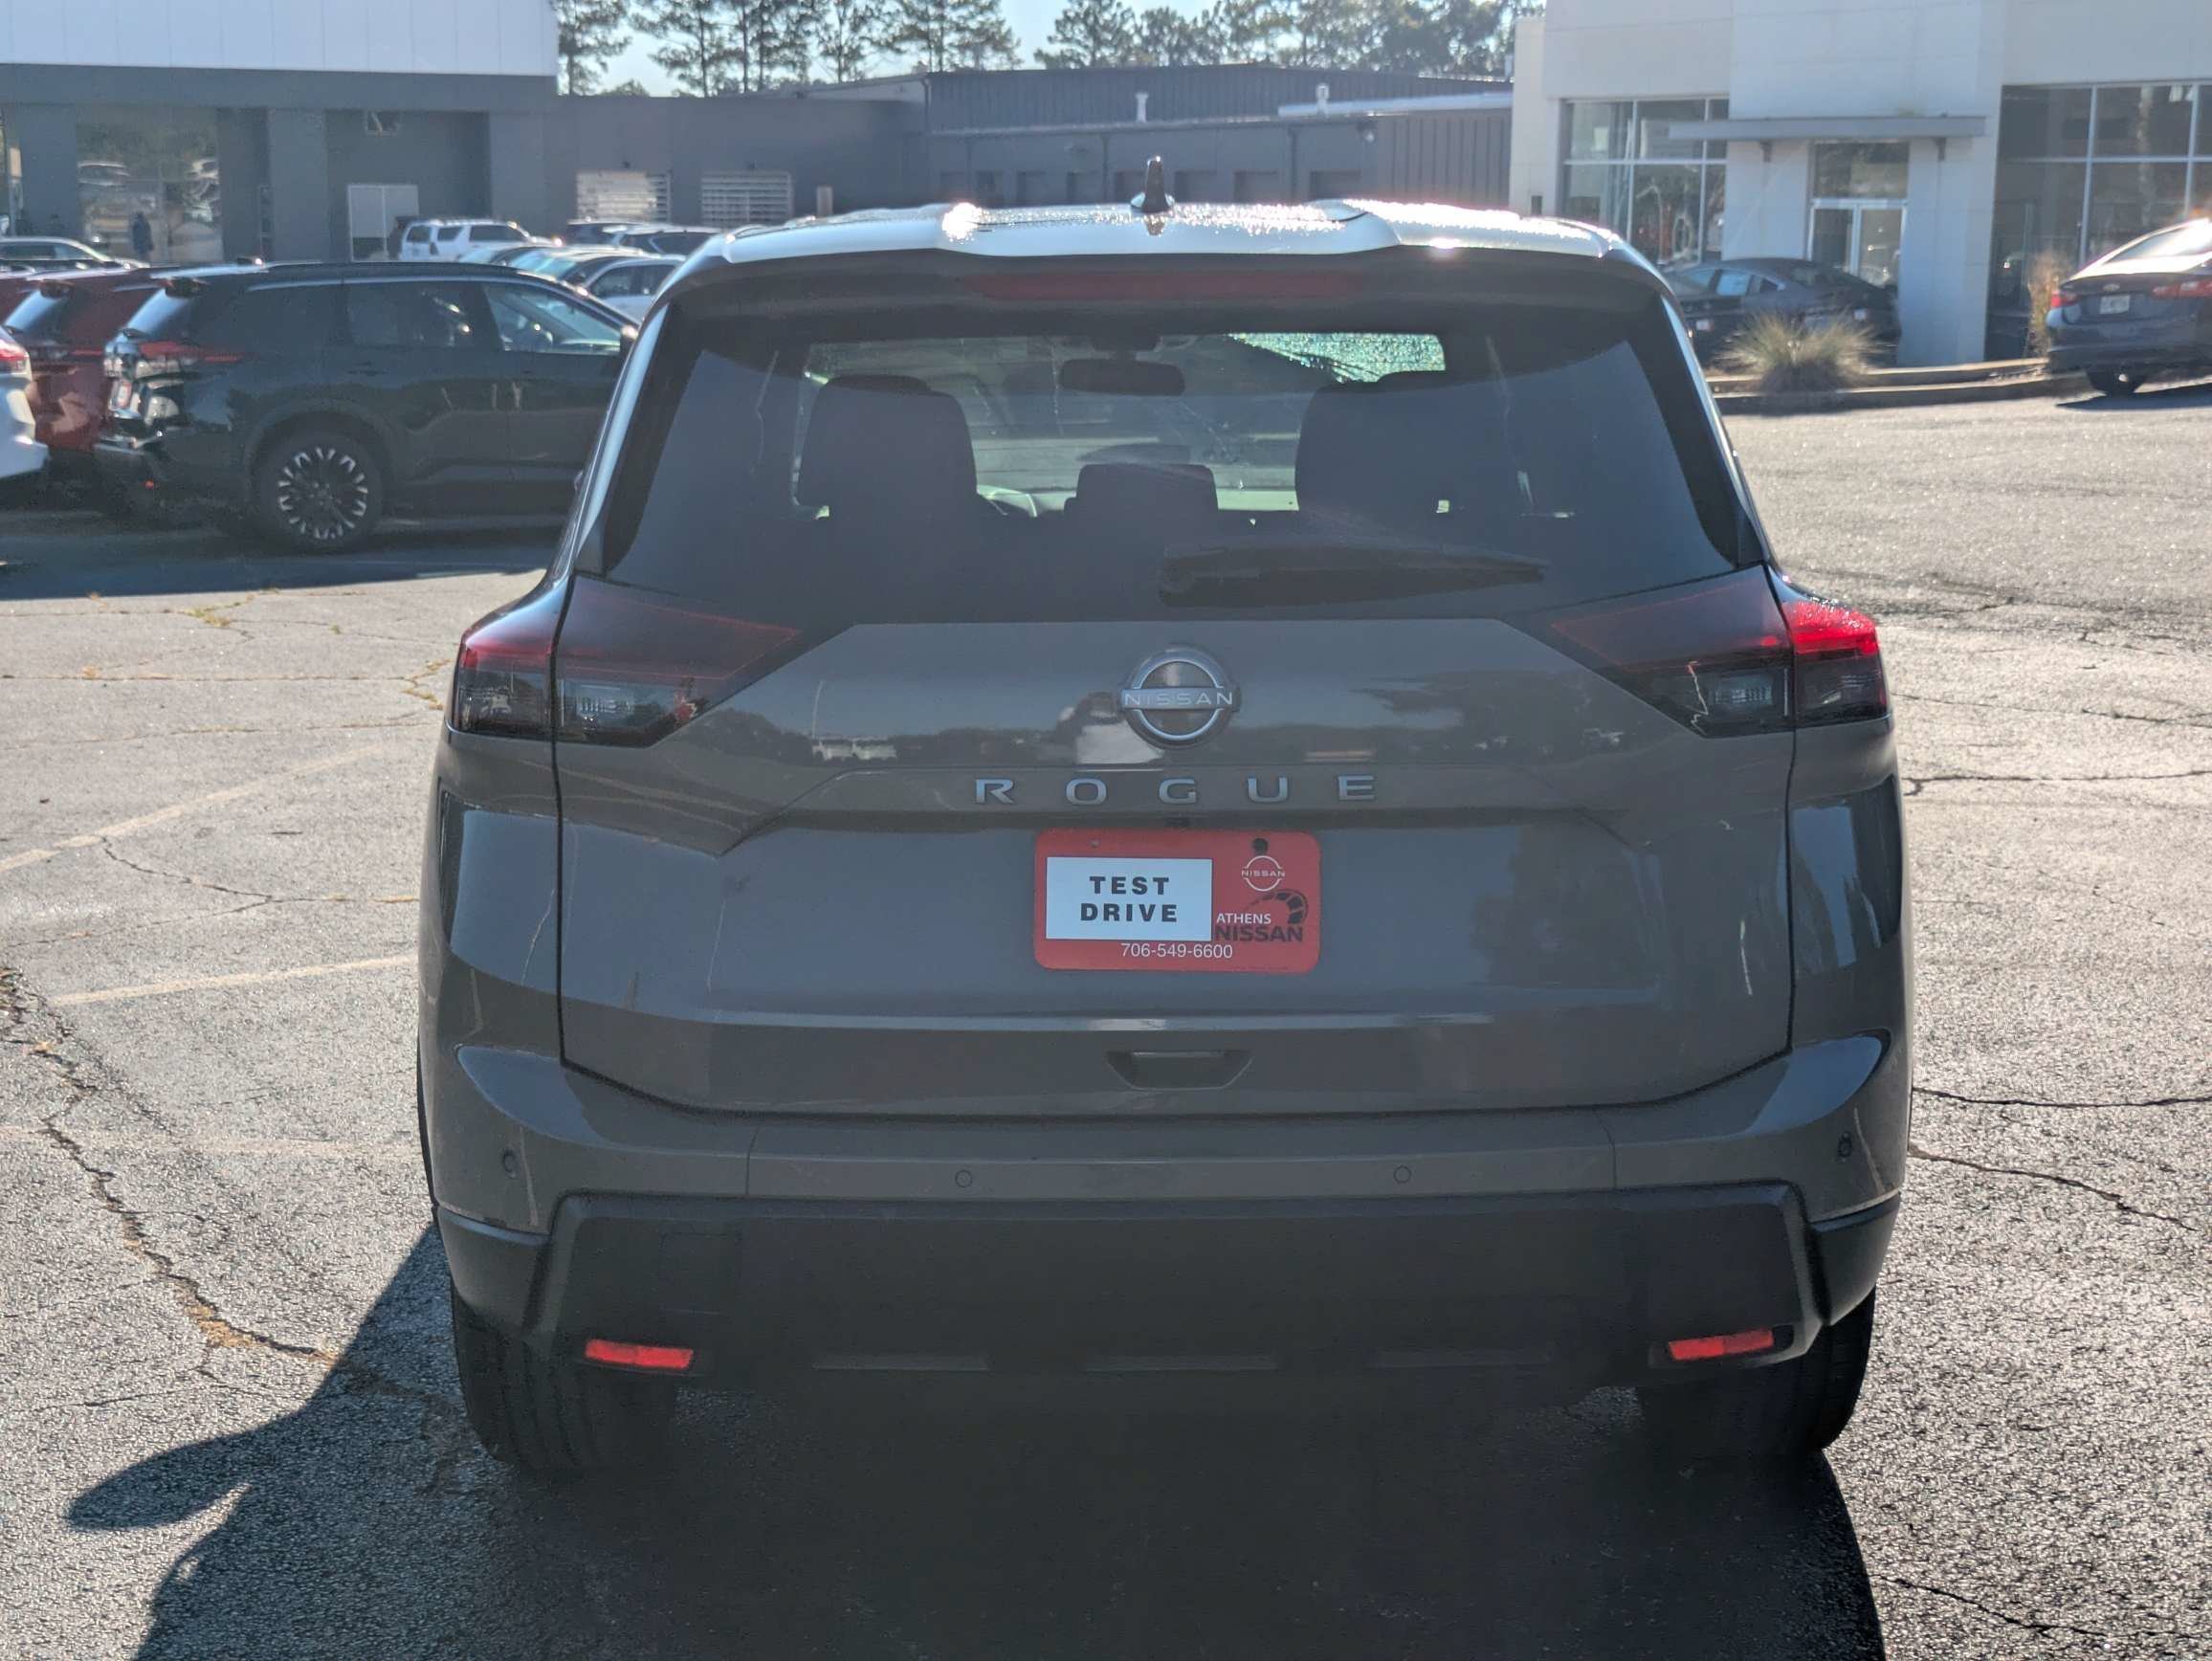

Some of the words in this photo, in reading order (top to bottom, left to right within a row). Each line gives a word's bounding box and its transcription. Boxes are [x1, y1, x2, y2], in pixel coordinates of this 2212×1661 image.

[1124, 691, 1233, 706] NISSAN
[974, 774, 1377, 805] ROGUE
[1241, 869, 1286, 877] NISSAN
[1089, 875, 1170, 896] TEST
[1080, 902, 1178, 923] DRIVE
[1215, 912, 1272, 925] ATHENS
[1214, 925, 1304, 942] NISSAN
[1119, 942, 1234, 960] 706-549-6600
